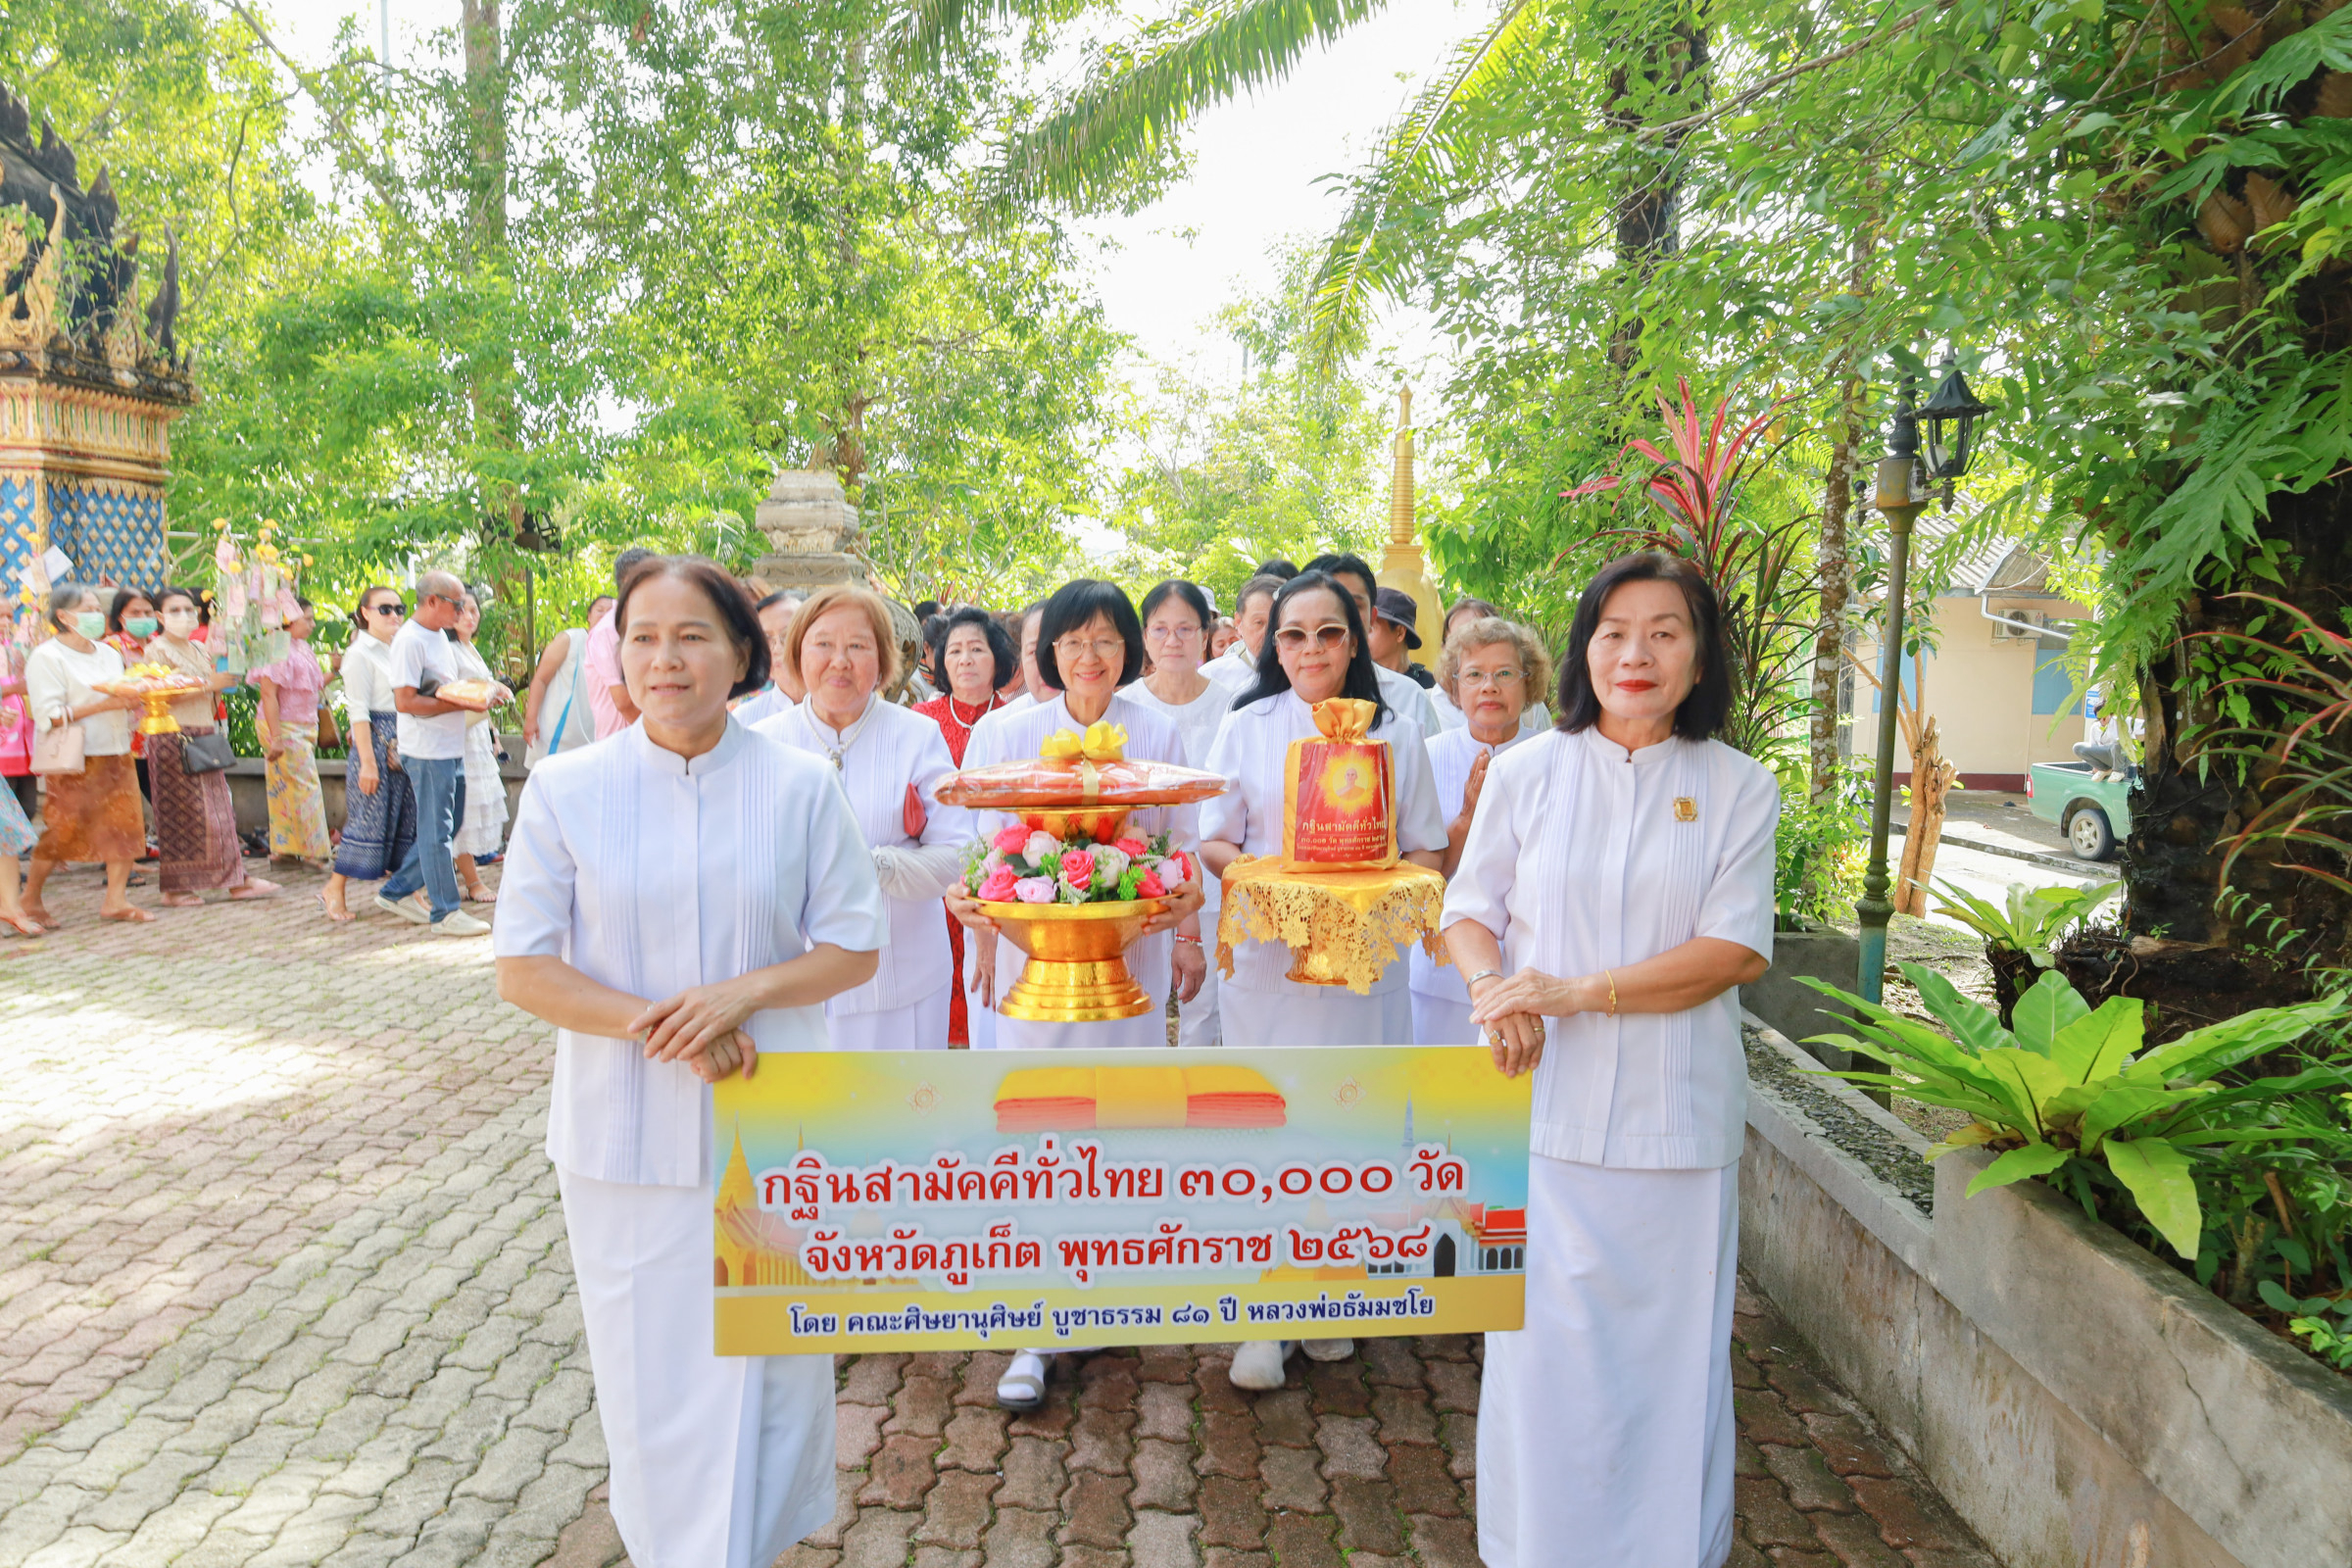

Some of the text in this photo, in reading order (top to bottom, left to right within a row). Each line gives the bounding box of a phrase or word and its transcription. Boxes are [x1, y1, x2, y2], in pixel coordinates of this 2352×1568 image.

[764, 1140, 1463, 1220] กฐินสามัคคีทั่วไทย ๓๐,๐๐๐ วัด
[807, 1222, 1432, 1286] จังหวัดภูเก็ต พุทธศักราช ๒๕๖๘
[790, 1288, 1434, 1339] โดย คณะศิษยานุศิษย์ บูชาธรรม ๘๑ ปี หลวงพ่อธัมมชโย
